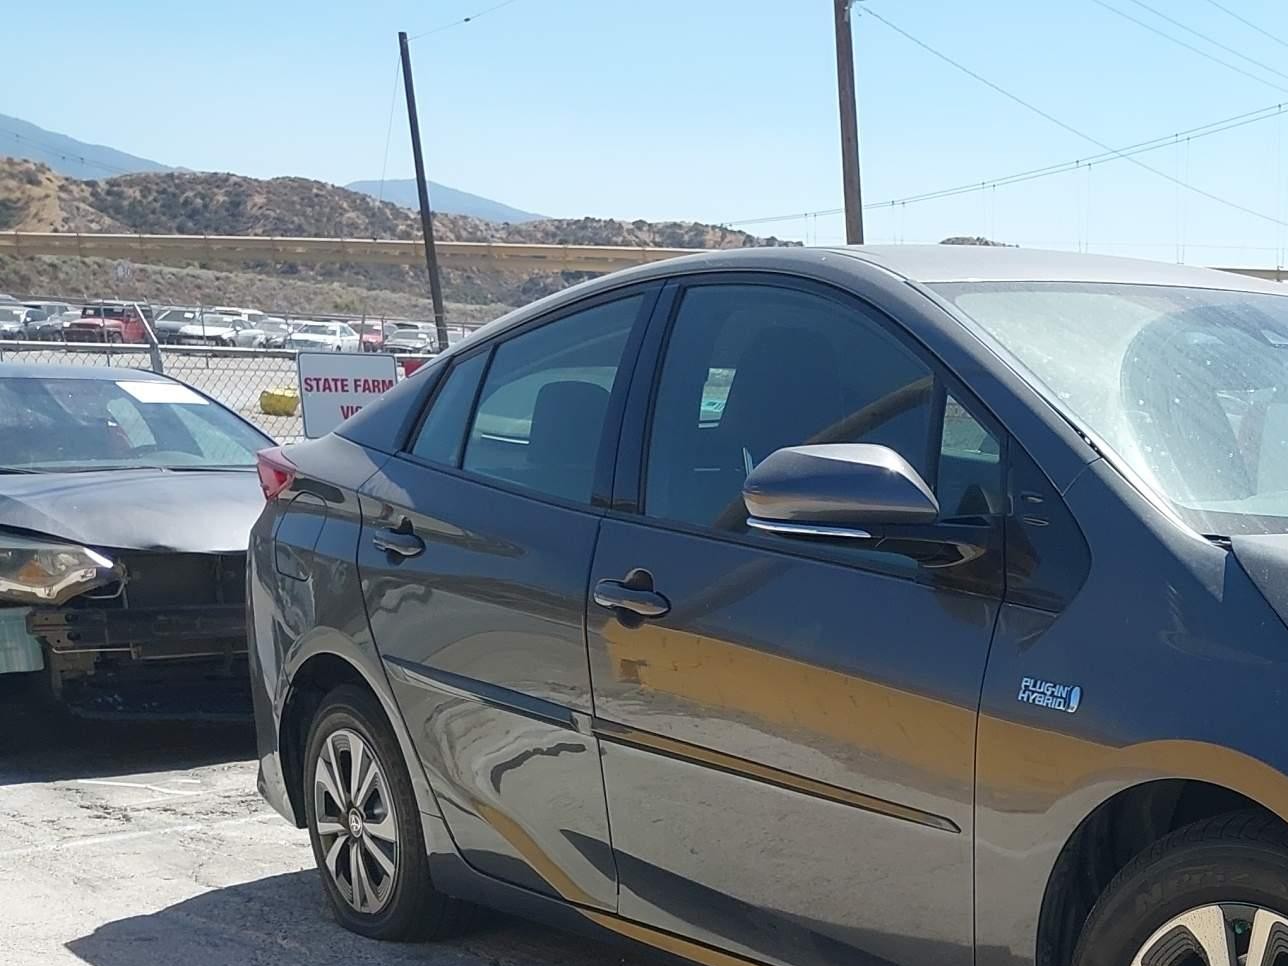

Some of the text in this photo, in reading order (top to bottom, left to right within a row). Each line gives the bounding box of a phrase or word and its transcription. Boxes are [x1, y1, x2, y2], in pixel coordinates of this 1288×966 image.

[304, 377, 393, 393] STATE FARM
[1018, 690, 1066, 711] HYBRID
